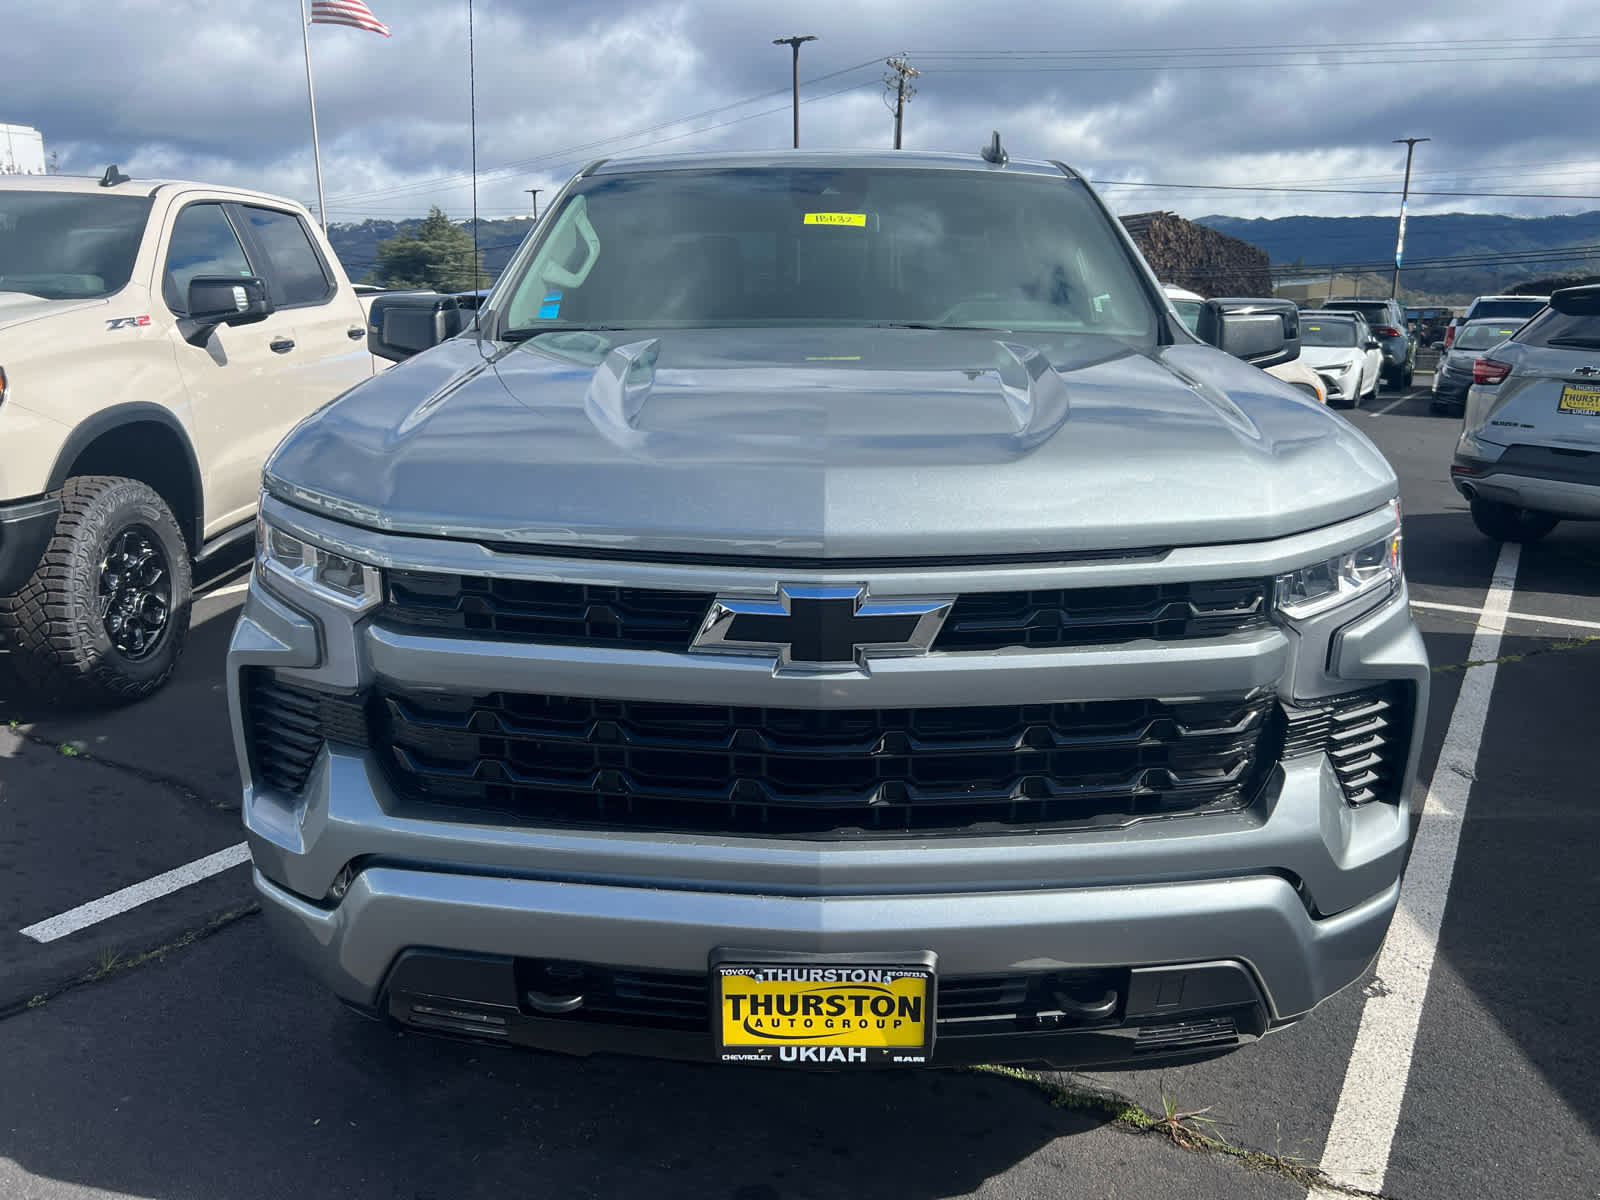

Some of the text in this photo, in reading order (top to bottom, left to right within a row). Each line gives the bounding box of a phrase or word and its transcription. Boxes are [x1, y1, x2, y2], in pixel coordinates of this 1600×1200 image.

[105, 315, 151, 331] ZR2
[763, 968, 882, 983] THURSTON
[725, 994, 922, 1023] THURSTON
[755, 1018, 902, 1029] AUTO GROUP
[779, 1046, 867, 1063] UKIAH
